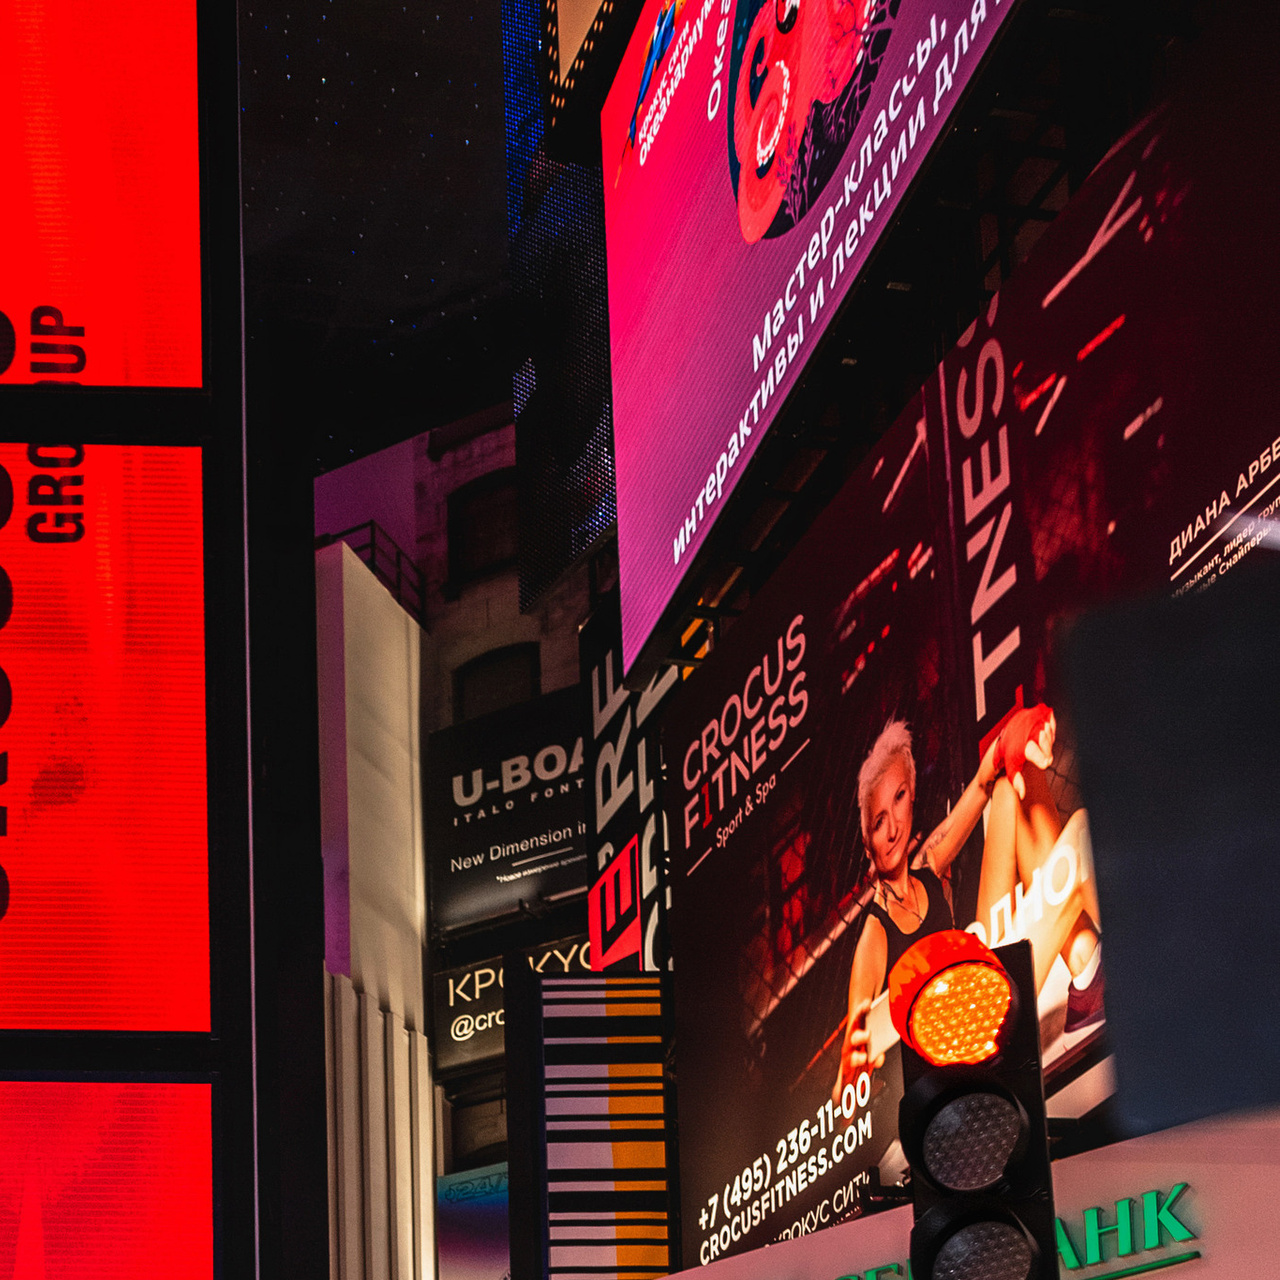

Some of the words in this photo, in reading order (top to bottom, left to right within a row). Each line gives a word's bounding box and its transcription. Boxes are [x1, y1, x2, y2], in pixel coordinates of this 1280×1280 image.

[752, 13, 947, 372] Мастер-классы,
[673, 313, 805, 565] интерактивы
[809, 276, 825, 324] и
[829, 96, 926, 290] лекции
[1169, 489, 1231, 566] ДИАНА
[683, 613, 807, 792] CROCUS
[450, 852, 485, 873] New
[489, 826, 572, 861] Dimension
[453, 800, 515, 827] ITALO
[716, 806, 745, 848] Sport
[744, 795, 754, 816] &
[755, 773, 777, 804] Spa
[698, 1193, 719, 1231] +7
[723, 1153, 771, 1219] (495)
[776, 1071, 871, 1175] 236-11-00
[699, 1110, 873, 1266] CROCUSFITNESS.COM
